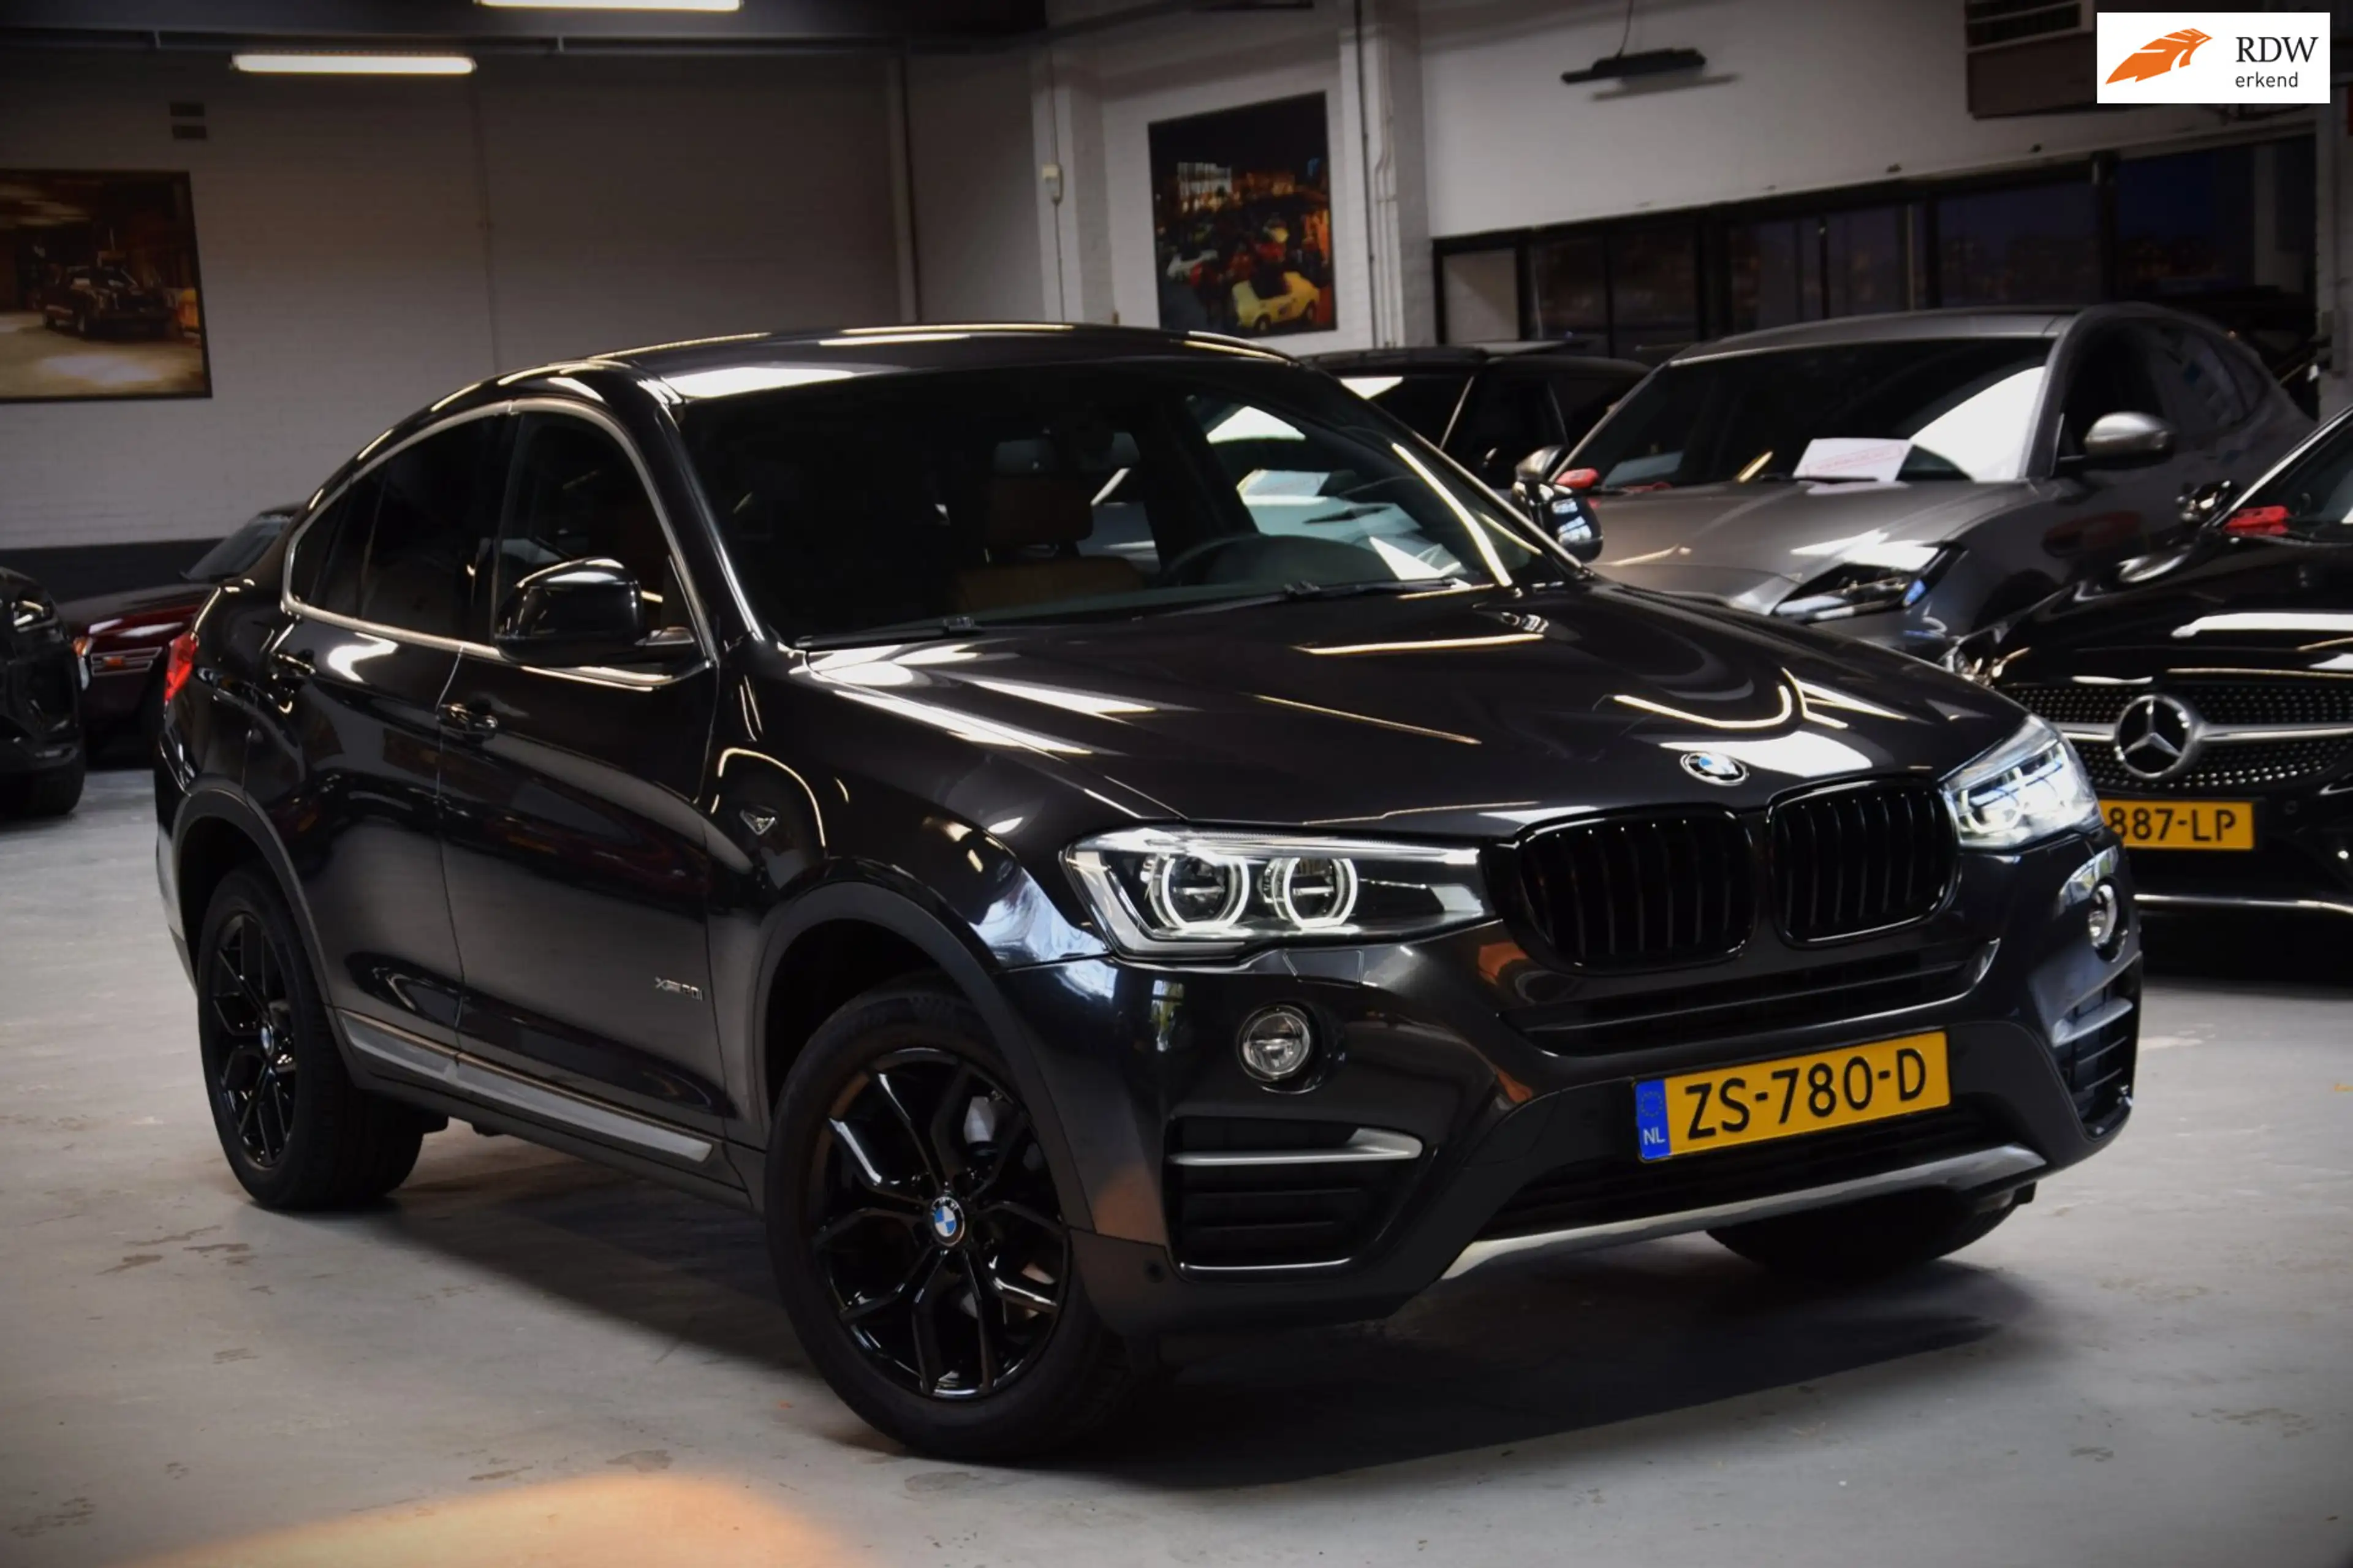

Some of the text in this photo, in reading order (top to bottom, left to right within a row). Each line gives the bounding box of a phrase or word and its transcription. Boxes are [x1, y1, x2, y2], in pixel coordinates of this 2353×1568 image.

[2109, 806, 2236, 841] 887-LP
[1684, 1047, 1927, 1140] ZS-780-D
[1643, 1126, 1666, 1146] NL
